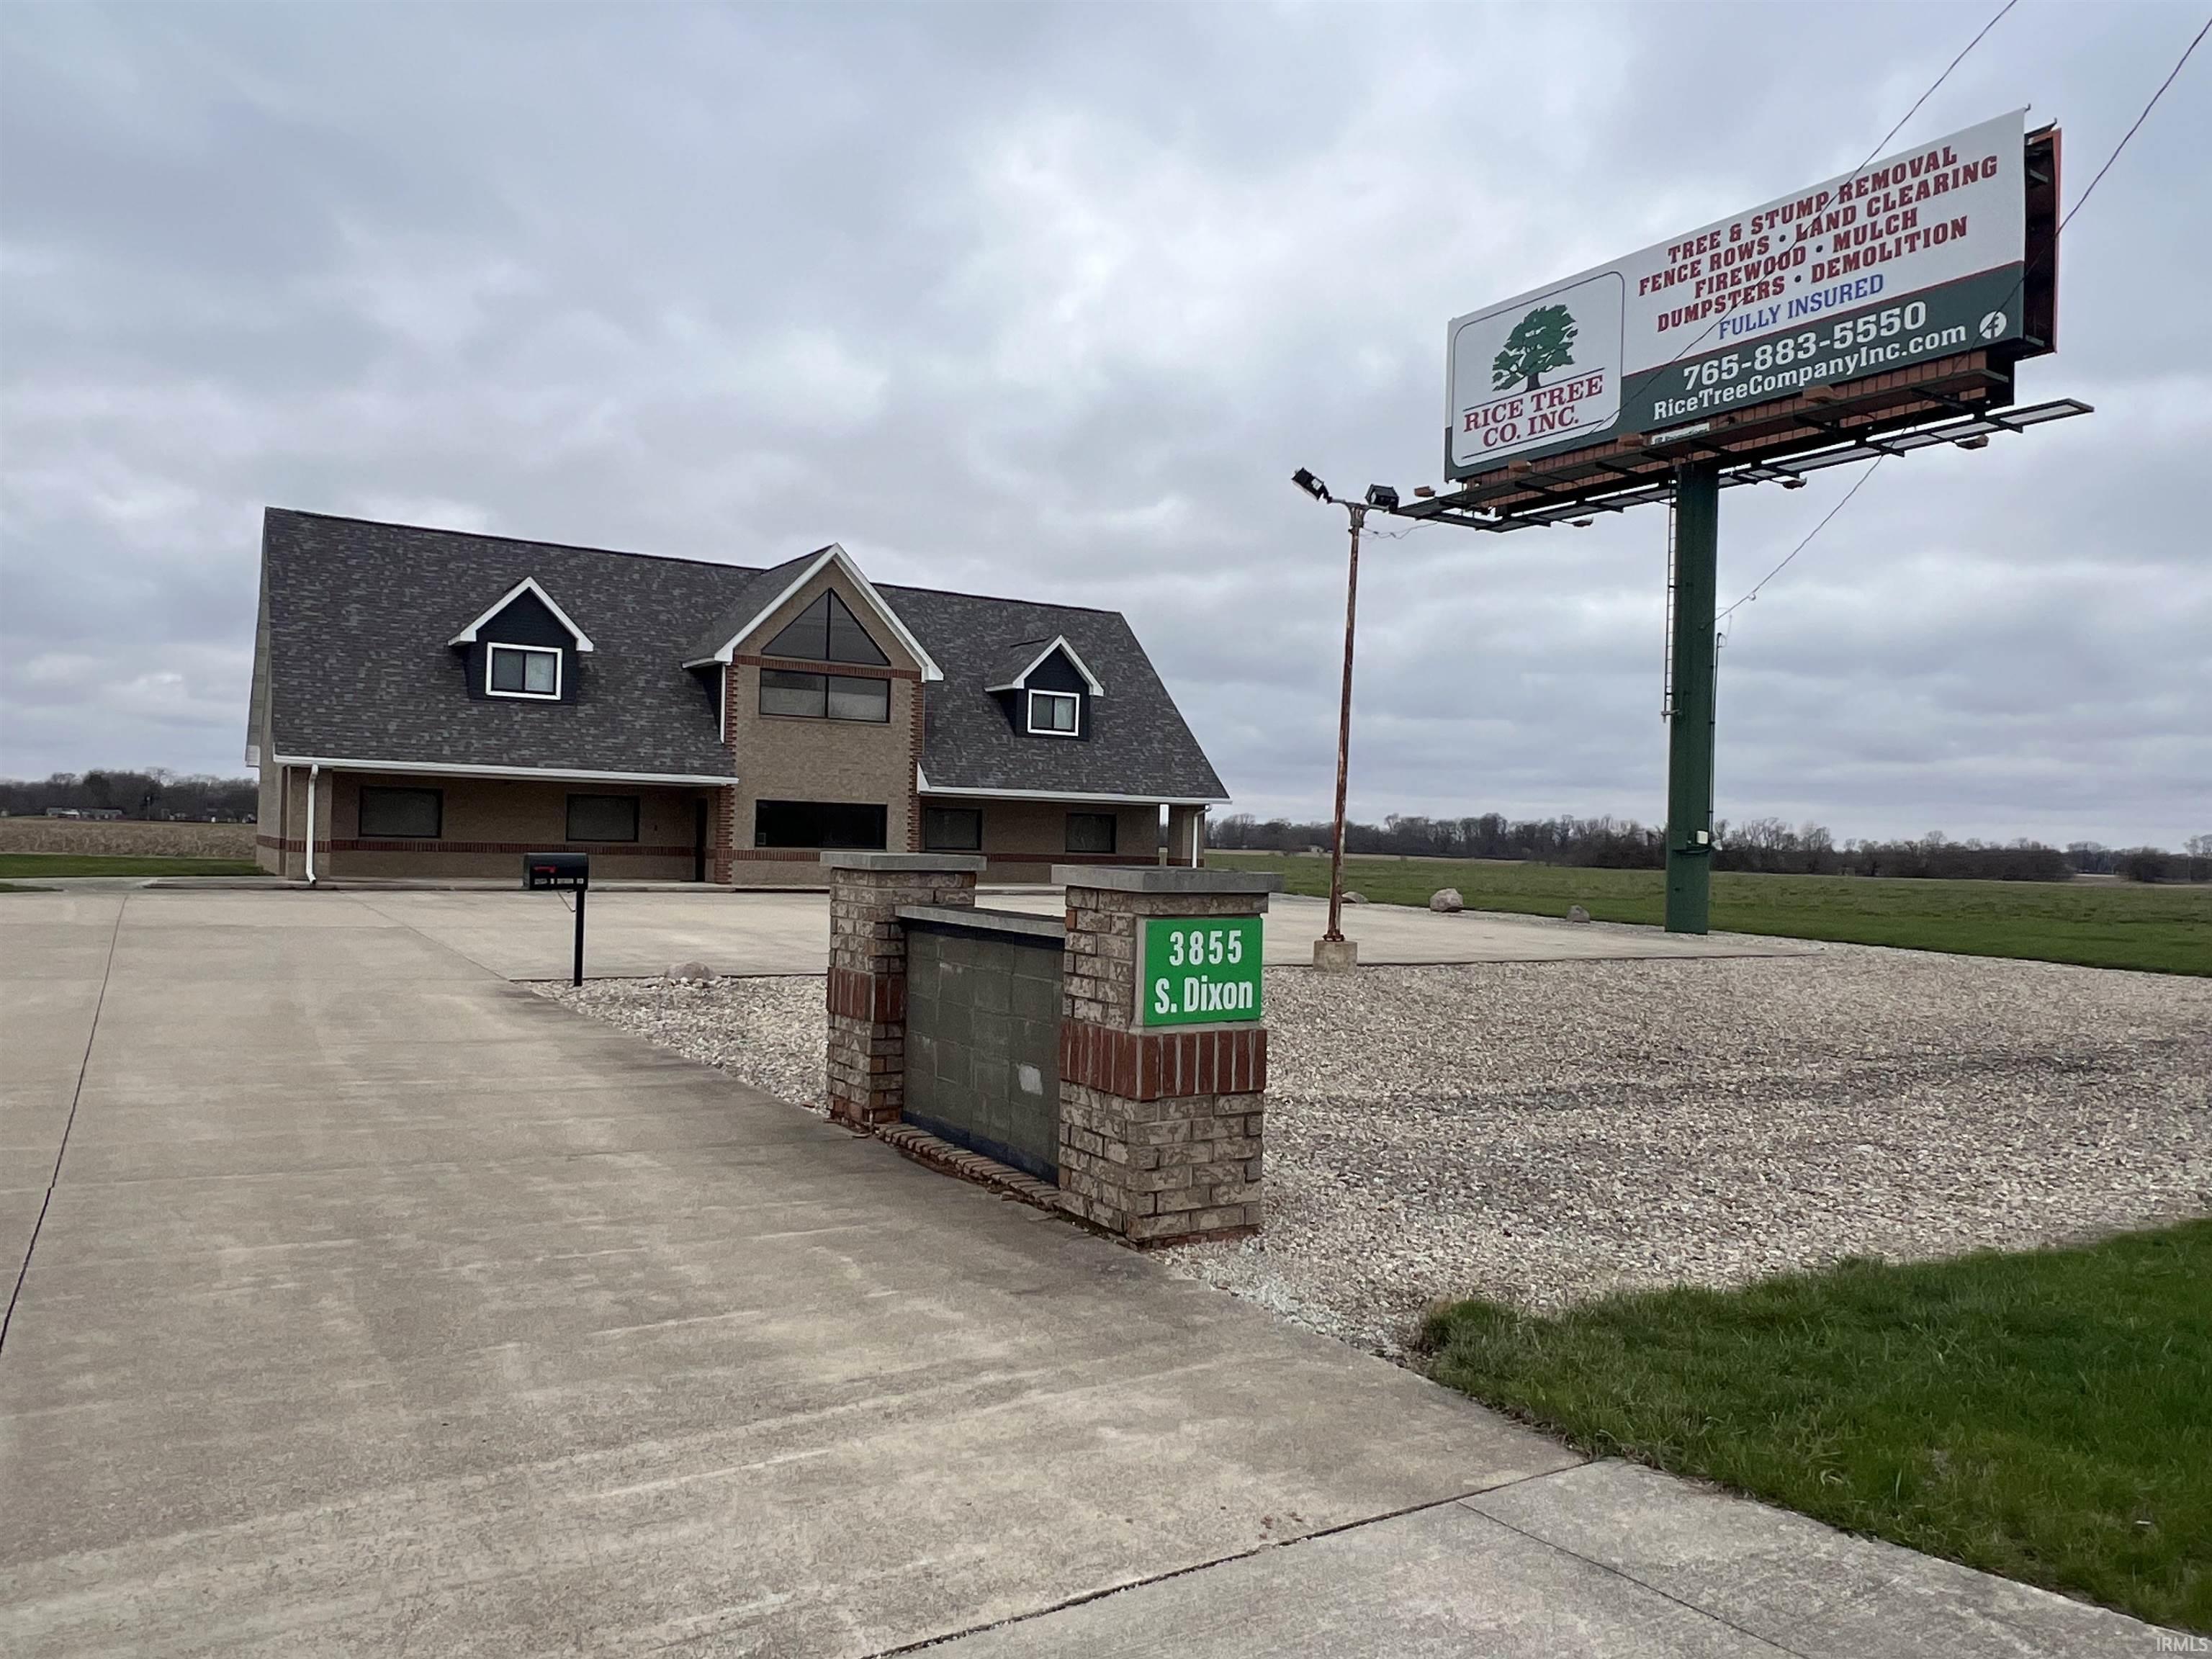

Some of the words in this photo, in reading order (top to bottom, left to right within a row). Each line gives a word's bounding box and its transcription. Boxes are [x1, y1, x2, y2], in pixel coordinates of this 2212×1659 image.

[1638, 258, 1701, 297] FENCE
[1709, 235, 1770, 272] ROWS
[1795, 205, 1856, 242] LAND
[1866, 155, 1997, 217] CLEARING
[1668, 230, 1722, 264] TREE
[1729, 223, 1743, 243] &
[1750, 191, 1830, 235] STUMP
[1838, 145, 1957, 204] REMOVAL
[1657, 276, 1785, 332] DUMPSTERS
[1811, 215, 1968, 284] DEMOLITION
[1694, 246, 1806, 299] FIREWOOD
[1833, 207, 1918, 253] MULCH
[1683, 301, 1926, 390] 765-883-5550
[1719, 305, 1781, 340] FULLY
[1787, 274, 1884, 319] INSURED
[1463, 398, 1524, 432] RICE
[1531, 374, 1603, 413] TREE
[1653, 325, 1966, 421] RiceTreeCompanyInc.com
[1483, 423, 1521, 447] CO.
[1527, 405, 1579, 436] INC.
[1169, 930, 1242, 966] 3855
[1154, 978, 1178, 1014] S.
[1184, 975, 1253, 1012] Dixon
